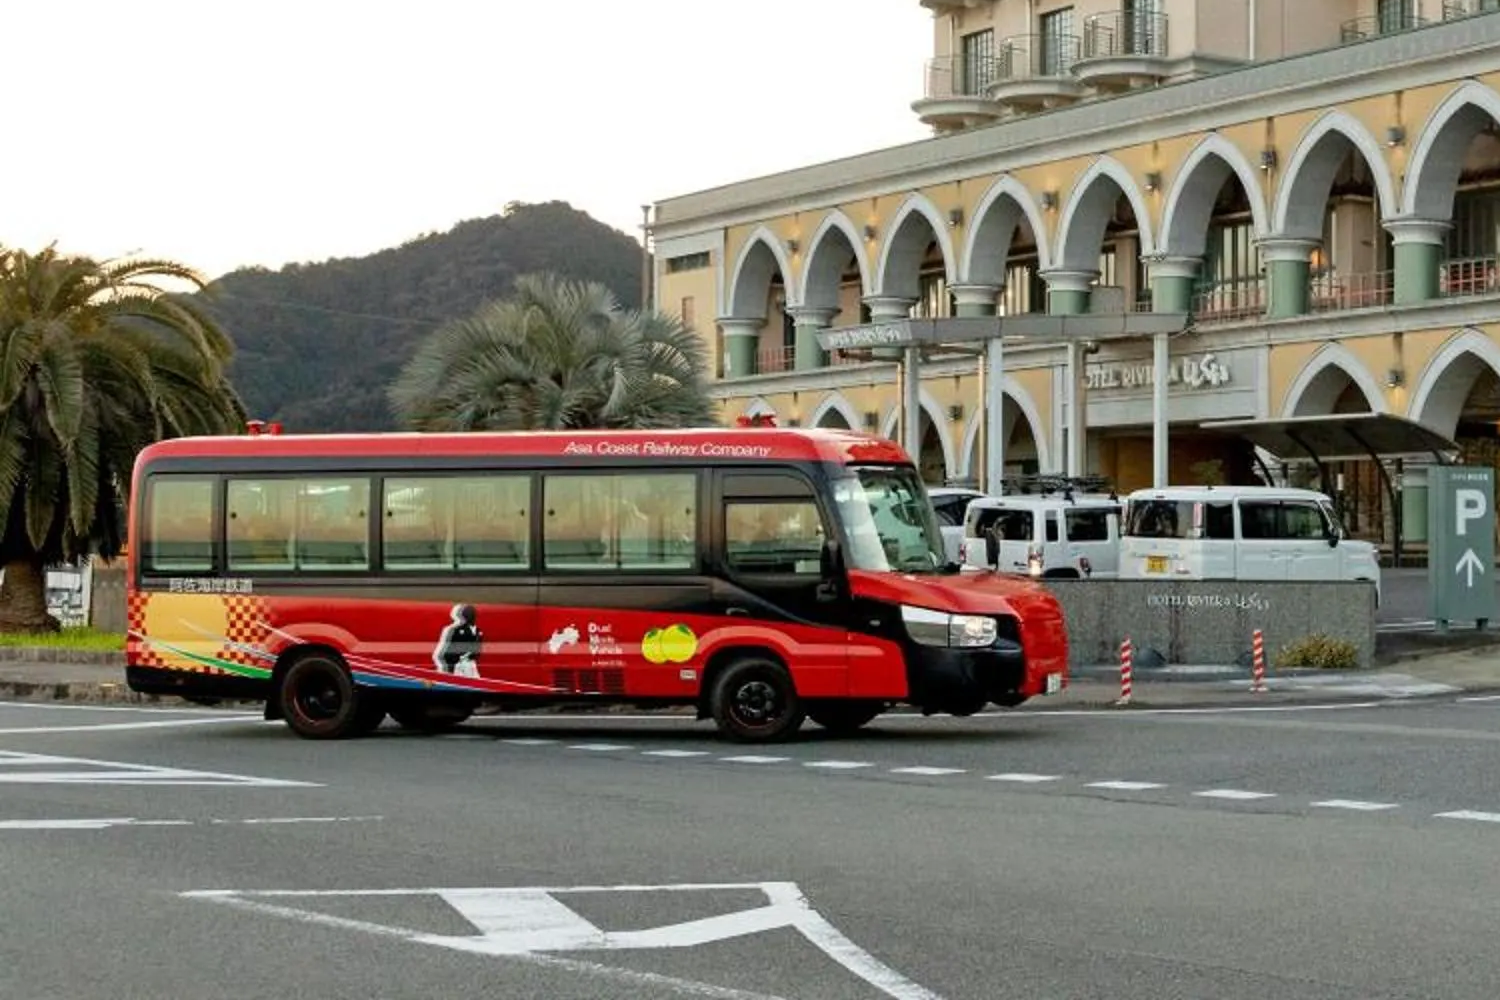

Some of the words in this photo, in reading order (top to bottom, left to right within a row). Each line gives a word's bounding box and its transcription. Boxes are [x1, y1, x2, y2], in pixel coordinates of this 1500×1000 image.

[563, 441, 592, 454] Asa
[597, 441, 639, 455] Coast
[643, 441, 697, 456] Railway
[701, 442, 771, 457] Company
[1456, 489, 1487, 535] P
